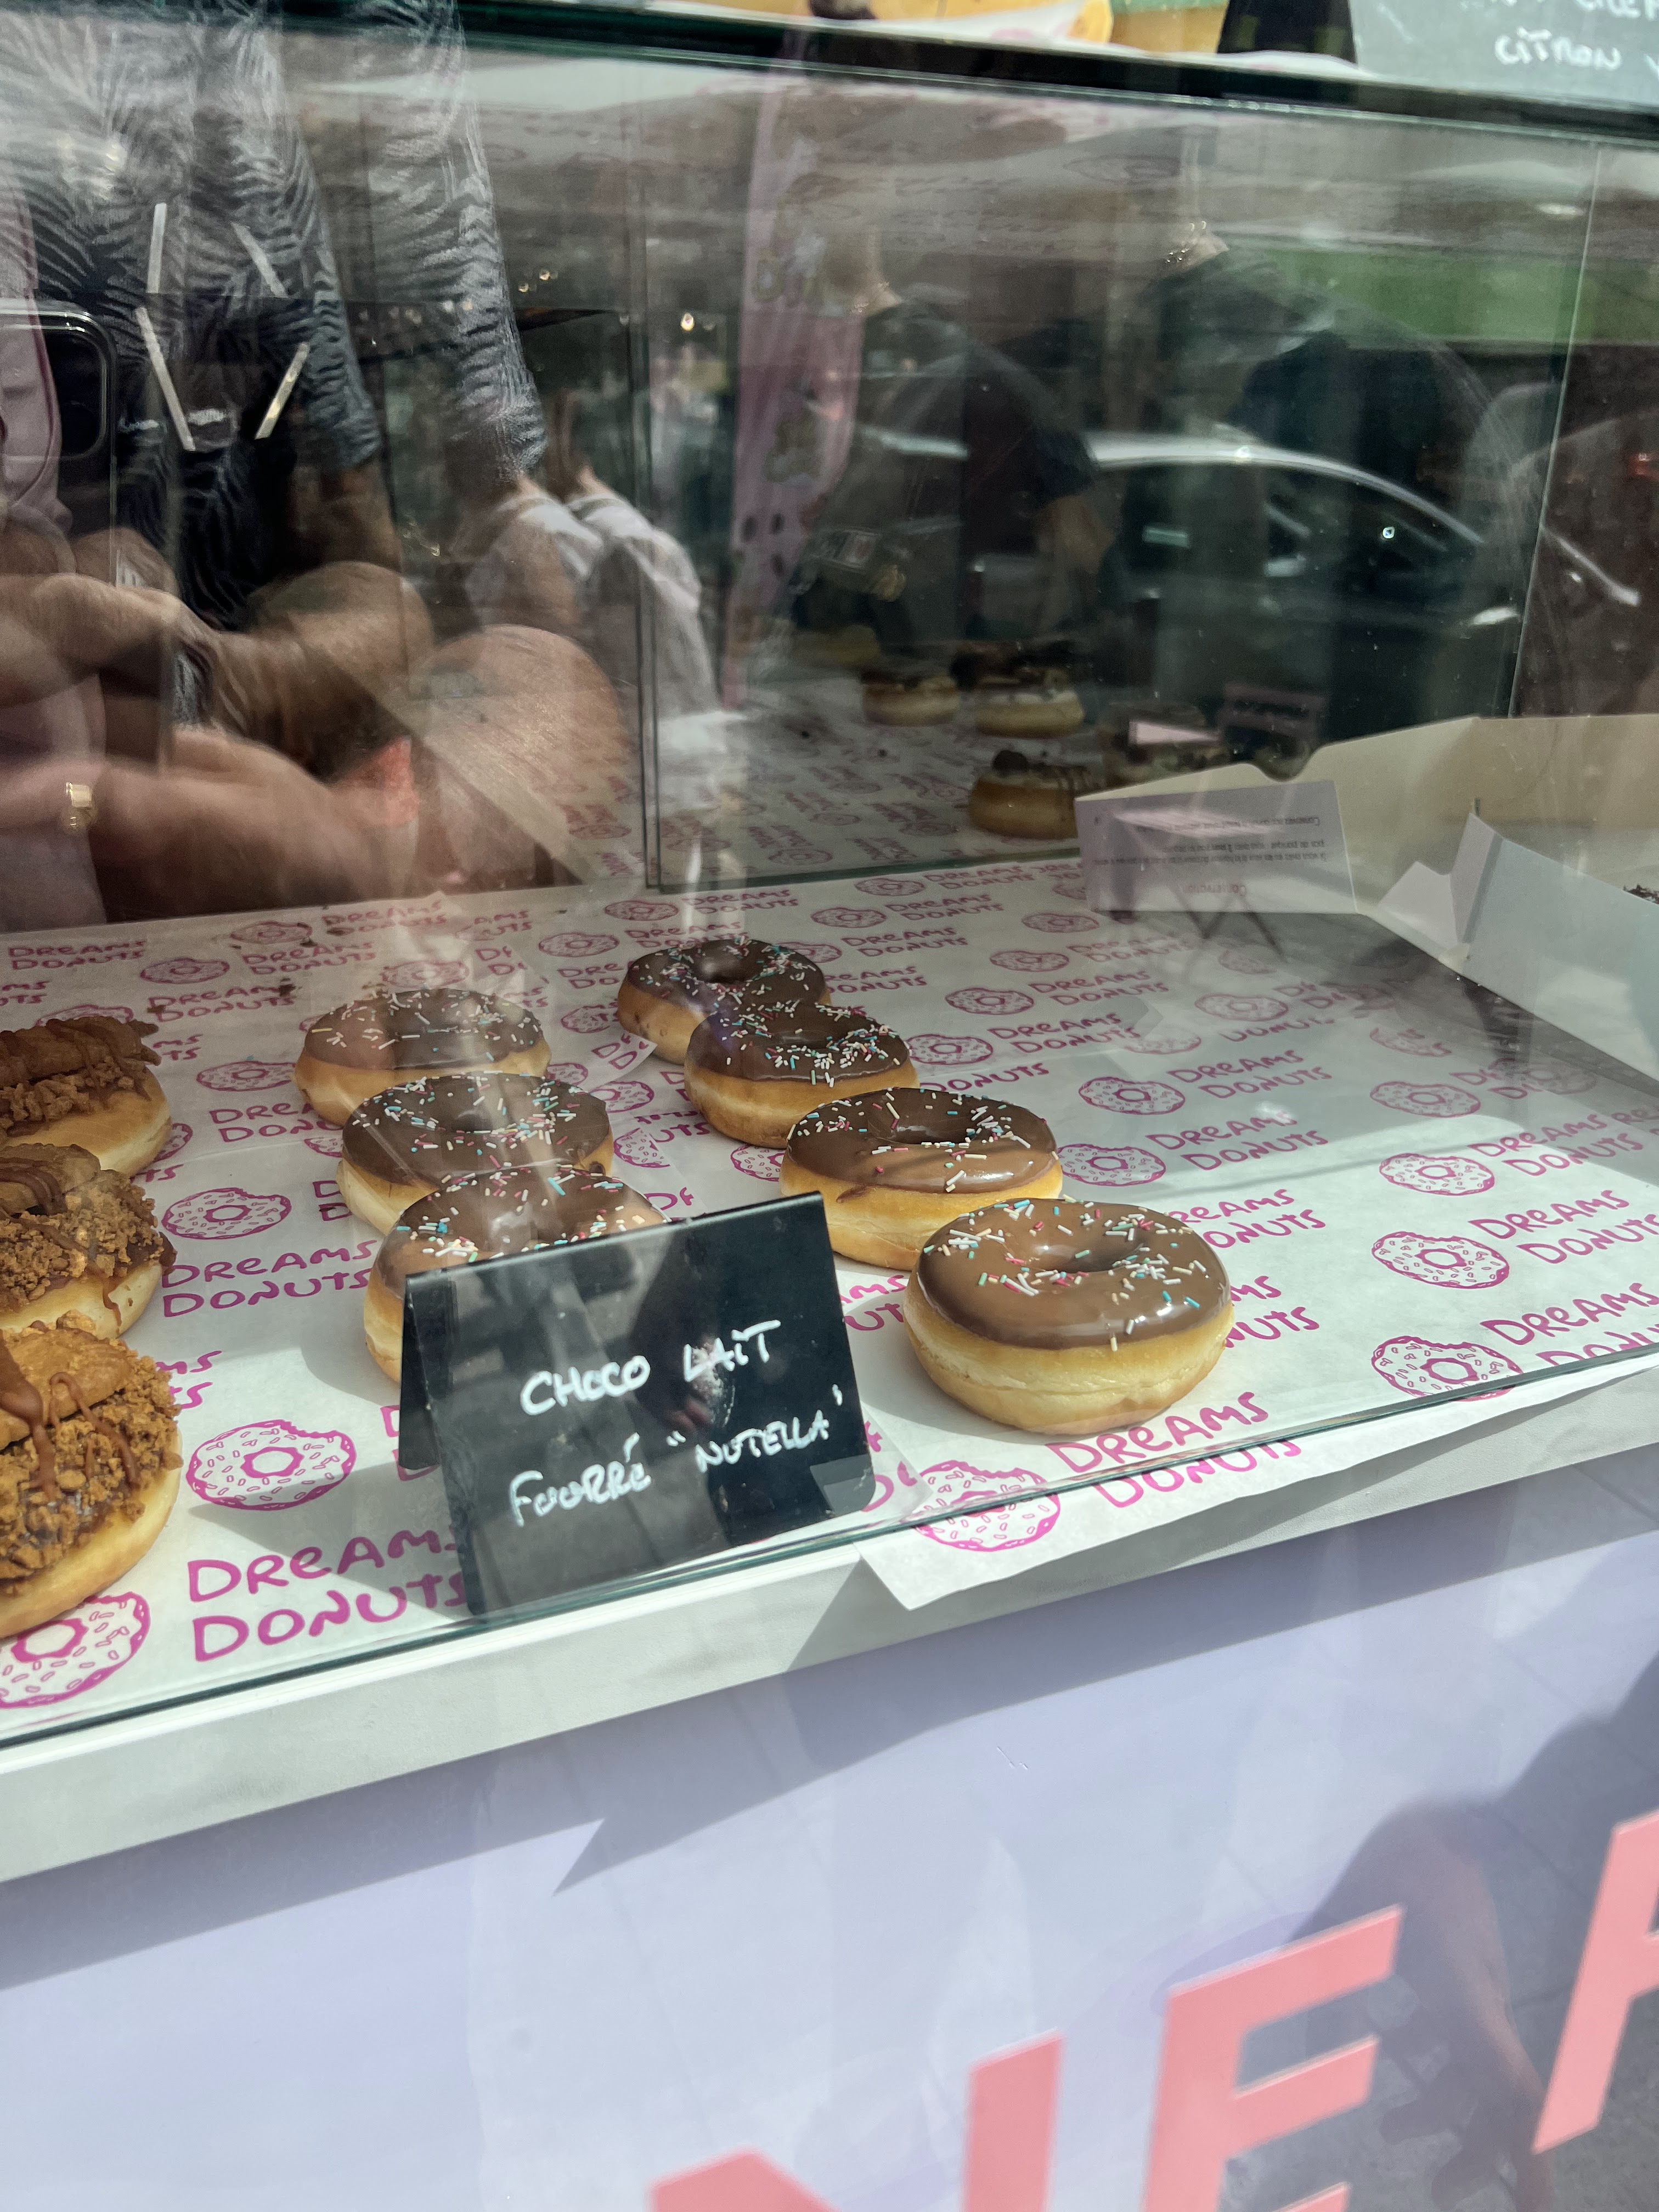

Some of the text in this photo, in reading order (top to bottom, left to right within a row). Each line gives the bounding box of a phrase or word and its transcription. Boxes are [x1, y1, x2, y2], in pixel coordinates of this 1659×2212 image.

[824, 966, 917, 981] REAMS
[1167, 1189, 1295, 1223] REAMS
[1203, 1209, 1326, 1248] ONUTS
[520, 1355, 651, 1415] CHOCO
